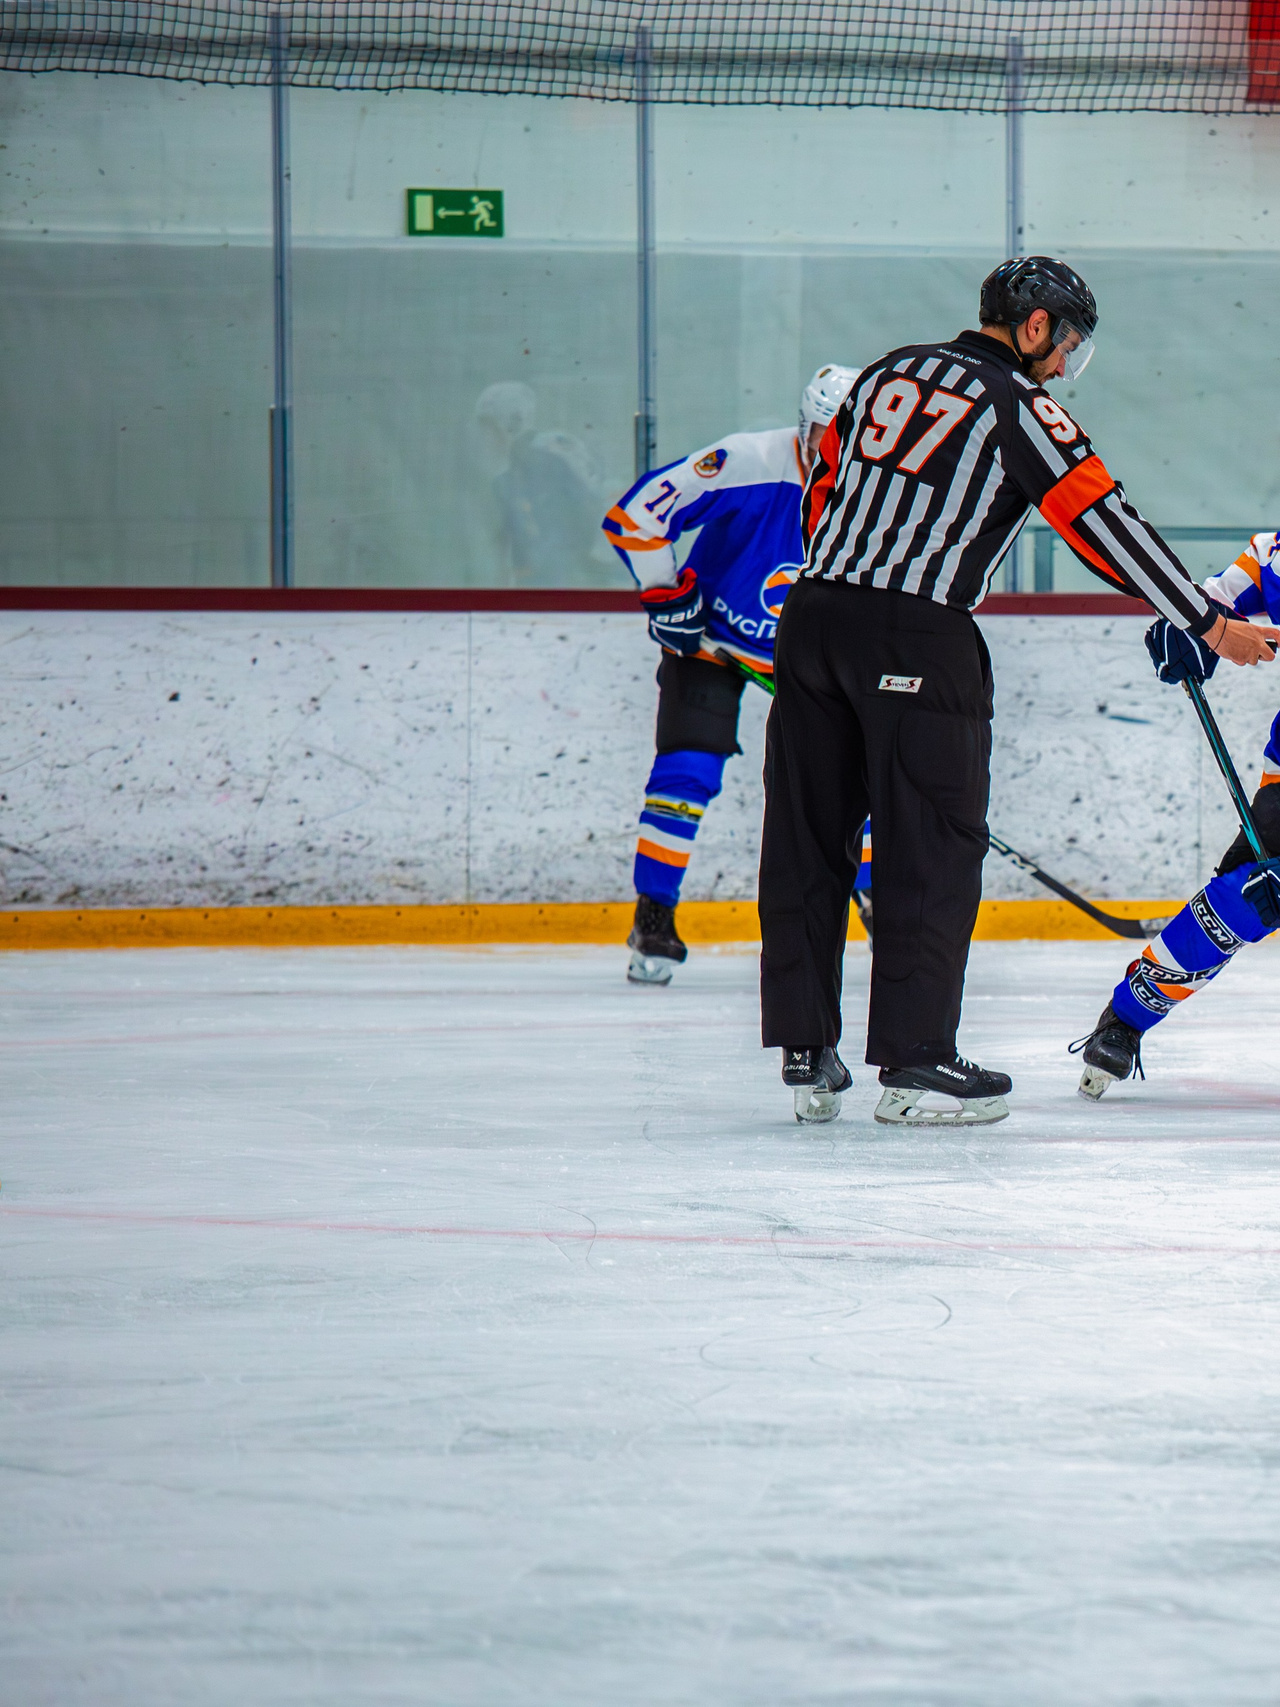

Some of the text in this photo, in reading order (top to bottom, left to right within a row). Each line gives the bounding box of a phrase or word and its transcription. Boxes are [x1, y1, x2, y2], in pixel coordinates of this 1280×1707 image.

[859, 376, 975, 475] 97
[643, 480, 682, 525] 71
[1195, 900, 1230, 945] CCM
[935, 1064, 968, 1082] BAUER
